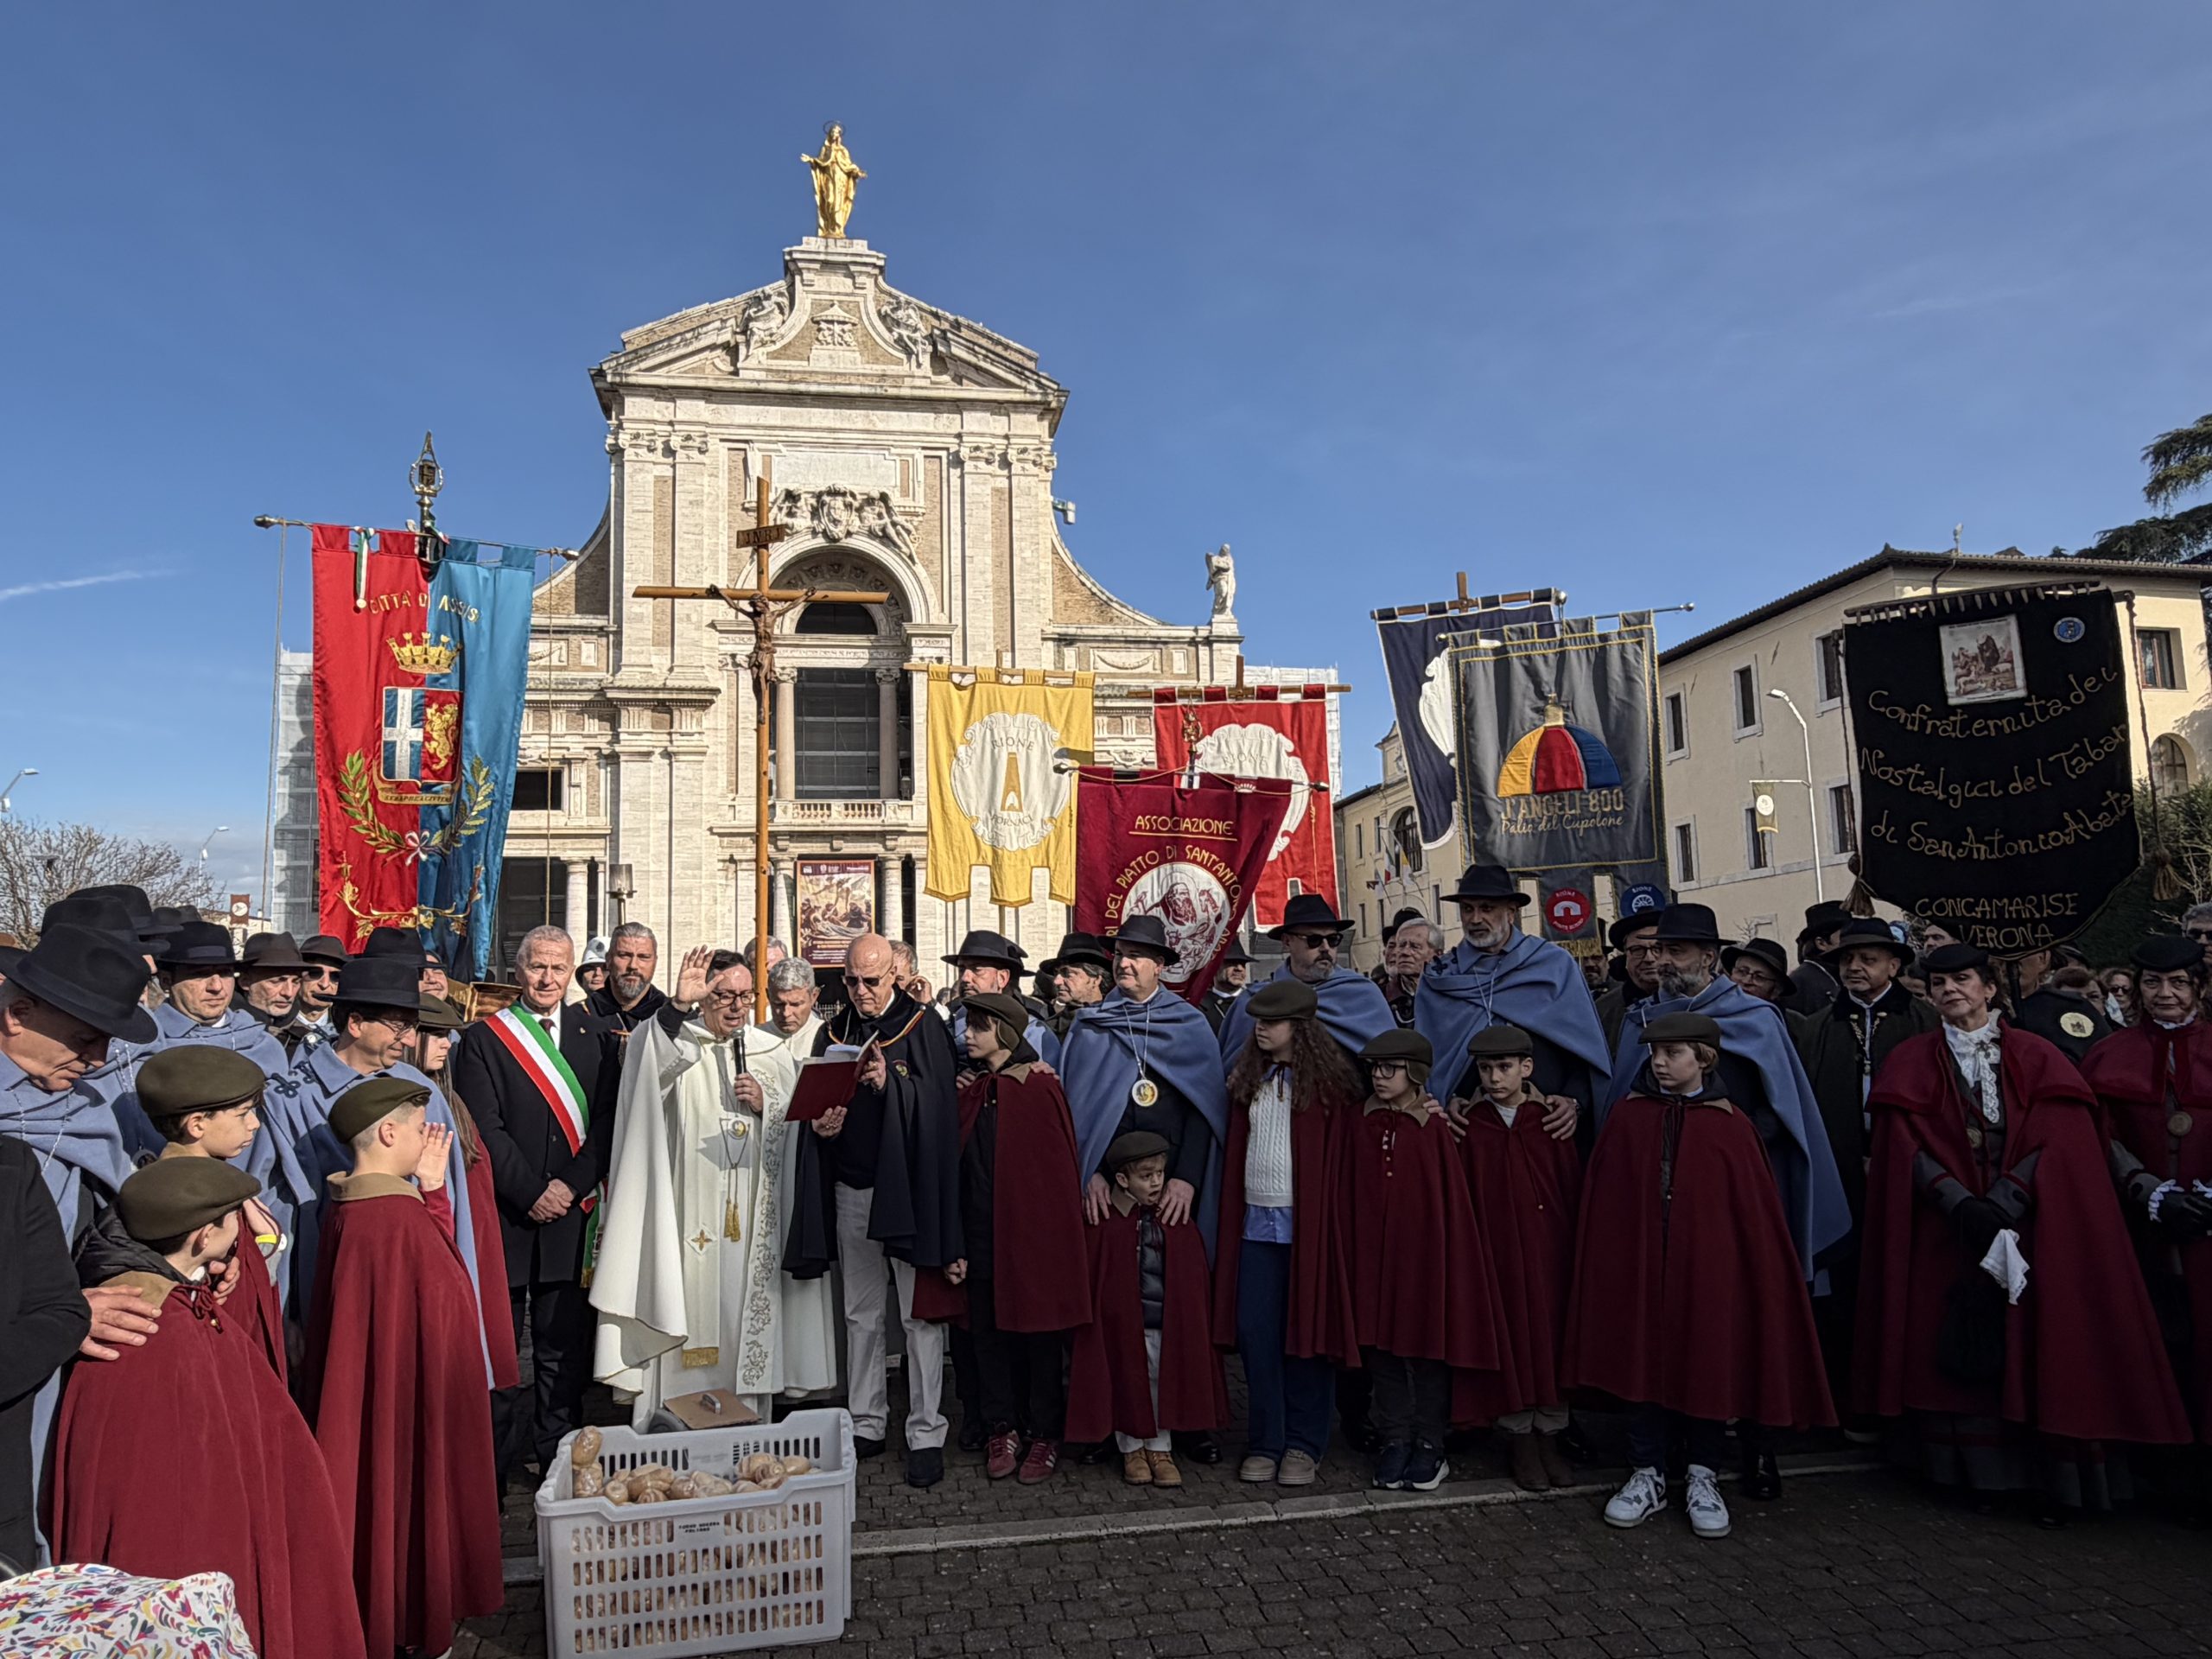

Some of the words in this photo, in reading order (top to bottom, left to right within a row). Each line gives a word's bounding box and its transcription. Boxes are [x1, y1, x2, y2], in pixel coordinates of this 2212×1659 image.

[439, 595, 479, 621] ASSIS
[1868, 690, 2072, 738] Confraternita
[2069, 667, 2117, 704] dei
[992, 737, 1034, 750] RIONE
[1860, 747, 2004, 808] Nostalgici
[2008, 758, 2052, 795] del
[2048, 723, 2126, 779] Tabar
[1588, 788, 1624, 813] 800
[1135, 815, 1234, 835] ASSOCIAZIONE
[1502, 816, 1534, 835] Palio
[1538, 815, 1558, 831] del
[1562, 811, 1624, 836] Cupolone
[1871, 810, 1898, 843] di
[1907, 822, 1956, 860] San
[1956, 826, 2064, 860] Antonio
[2063, 790, 2133, 845] Abate
[1105, 893, 1123, 918] DEL
[1116, 850, 1160, 888] PIATTO
[1166, 845, 1177, 859] DI
[1915, 893, 2080, 918] CONCAMARISE
[1959, 923, 2055, 948] VERONA
